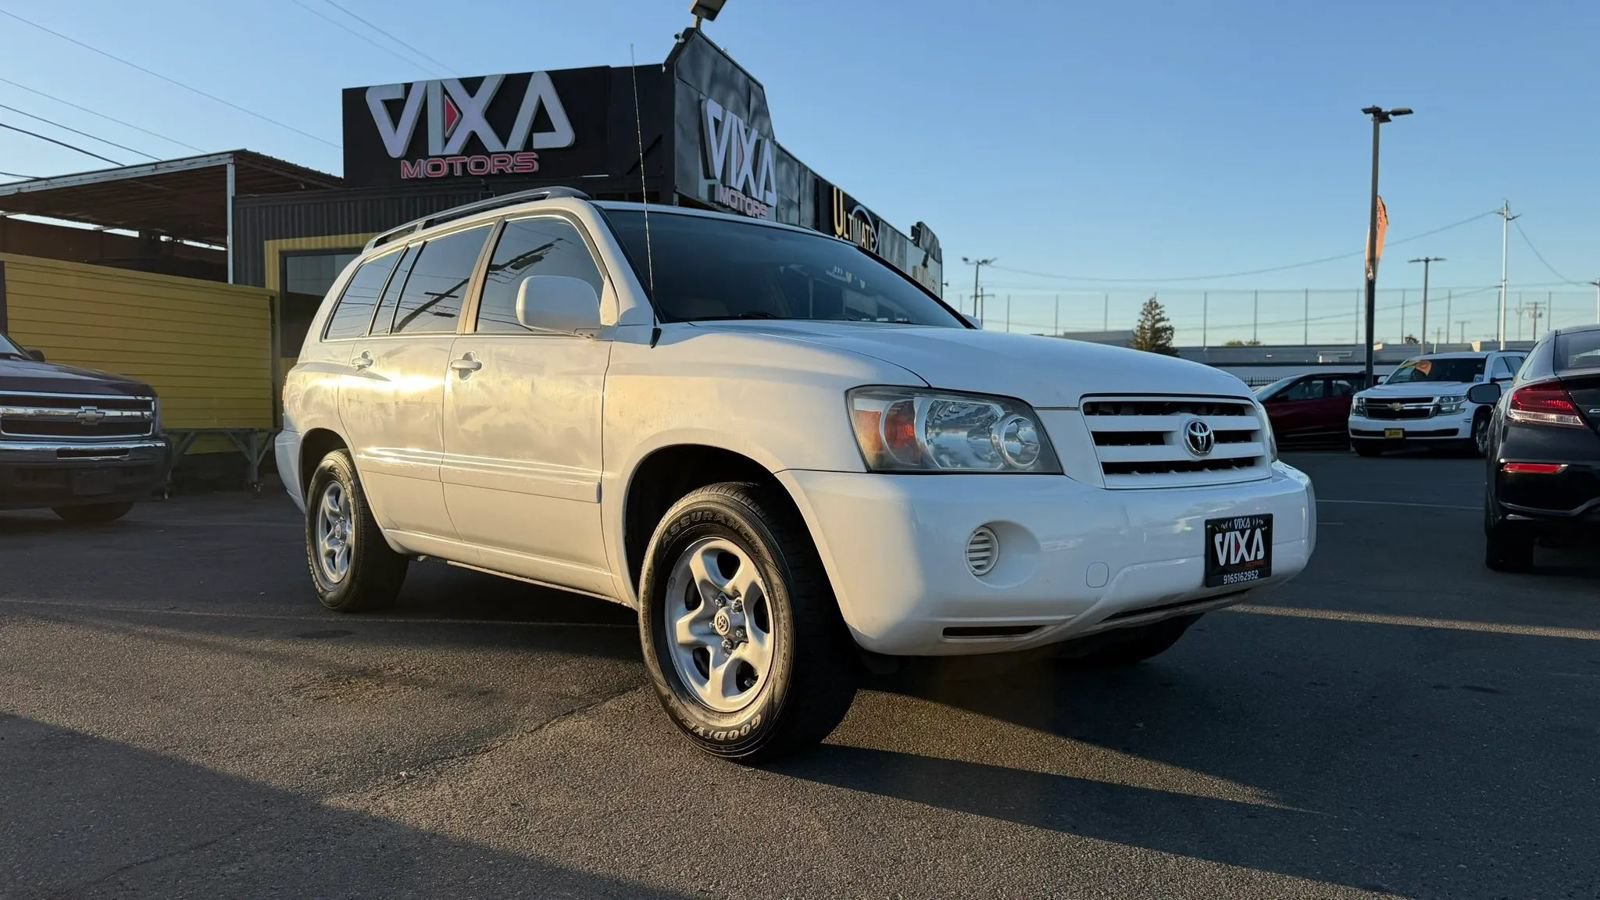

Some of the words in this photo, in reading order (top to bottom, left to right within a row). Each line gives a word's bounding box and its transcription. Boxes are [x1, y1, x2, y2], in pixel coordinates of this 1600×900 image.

[365, 71, 575, 158] VIXA
[400, 152, 539, 179] MOTORS
[703, 98, 777, 208] VIXA
[716, 184, 768, 219] MOTORS
[1234, 518, 1251, 529] VIXA
[1214, 528, 1264, 566] VIXA
[1223, 570, 1259, 585] 9165162952
